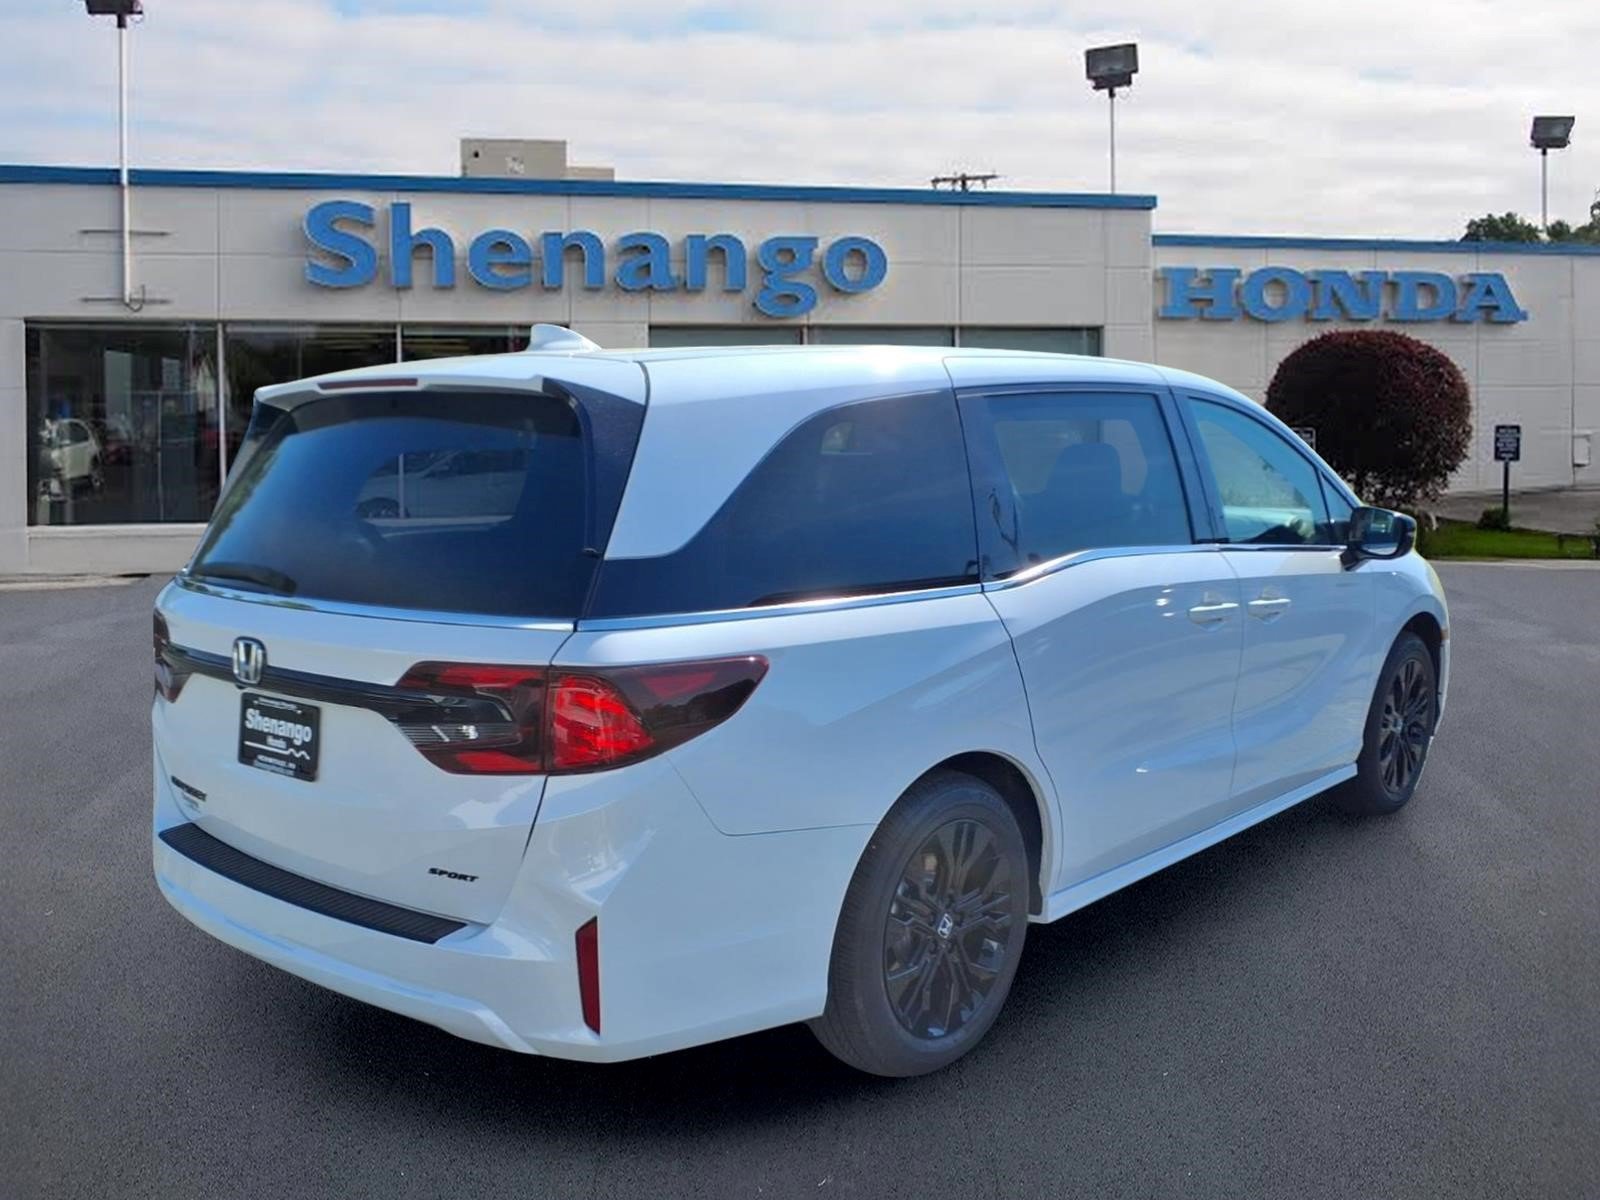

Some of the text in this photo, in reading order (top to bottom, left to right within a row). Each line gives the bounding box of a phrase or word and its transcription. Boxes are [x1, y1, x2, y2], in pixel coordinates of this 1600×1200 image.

[303, 199, 888, 319] Shenango
[1159, 266, 1528, 323] HONDA
[245, 708, 313, 746] Shenango
[428, 868, 479, 882] SPORT
